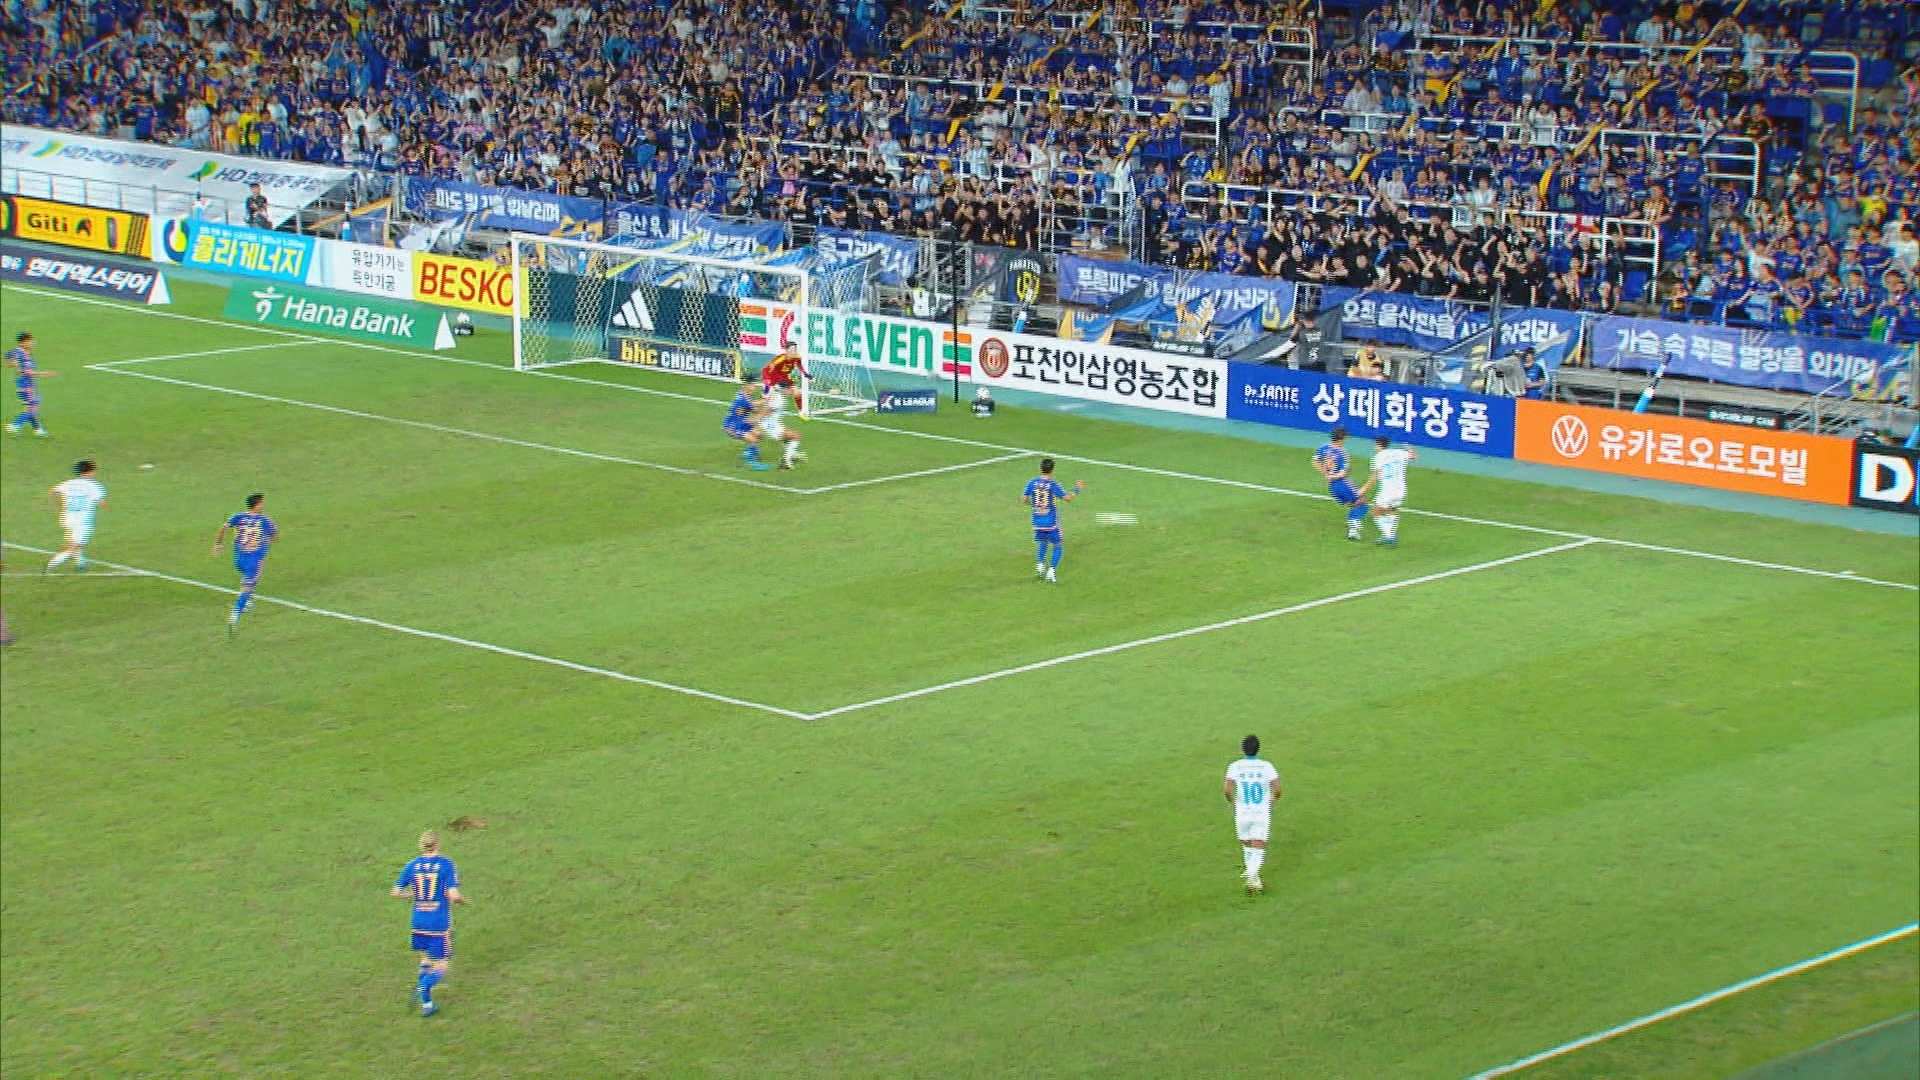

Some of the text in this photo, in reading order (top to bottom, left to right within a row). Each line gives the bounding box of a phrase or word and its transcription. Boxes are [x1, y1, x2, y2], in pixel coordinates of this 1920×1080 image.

[27, 213, 67, 232] Giti
[283, 295, 415, 338] Hana Bank
[621, 339, 658, 365] bhc
[1012, 344, 1220, 408] 포천인삼영농조합
[1312, 383, 1490, 443] 상떼화장품
[1599, 425, 1808, 487] 유카로오토모빌
[1241, 781, 1264, 804] 10
[413, 872, 439, 901] 17
